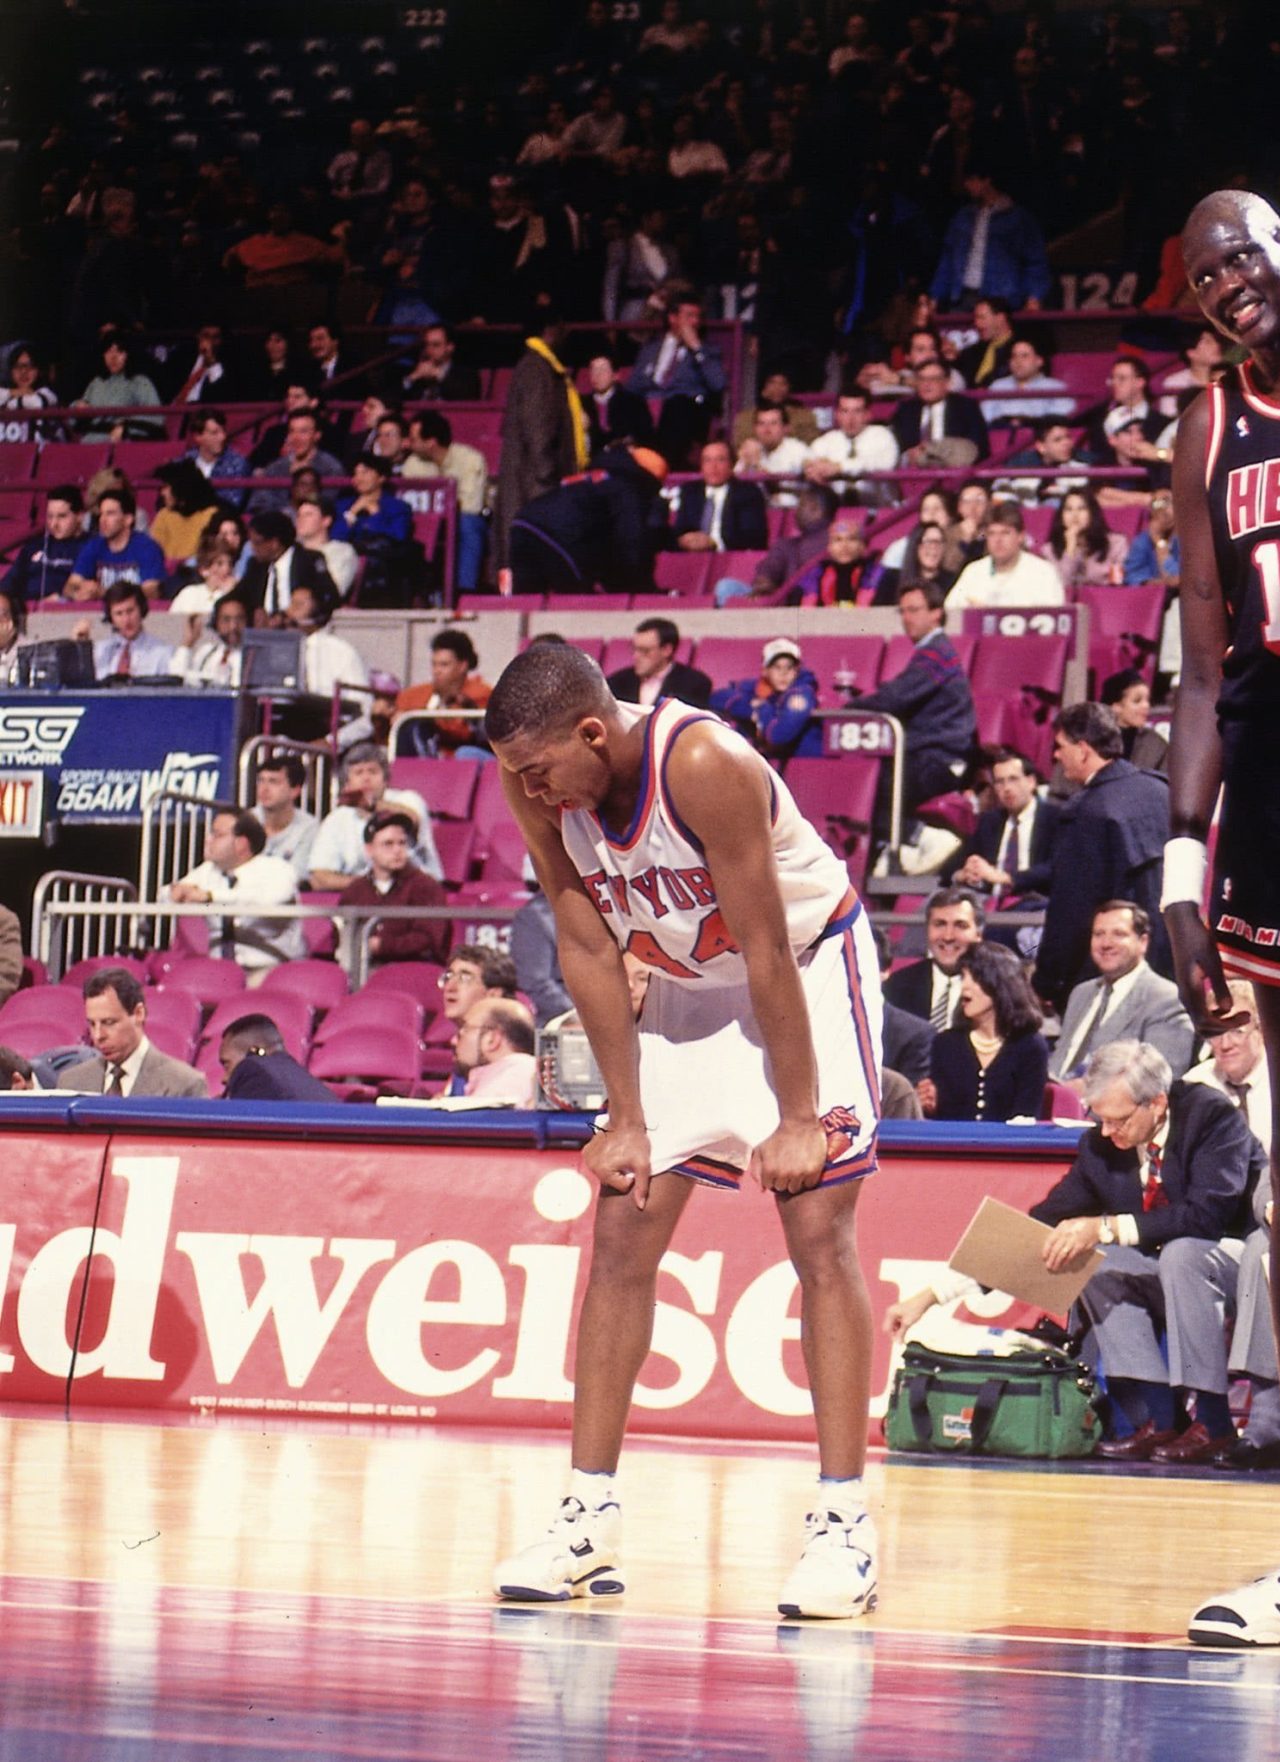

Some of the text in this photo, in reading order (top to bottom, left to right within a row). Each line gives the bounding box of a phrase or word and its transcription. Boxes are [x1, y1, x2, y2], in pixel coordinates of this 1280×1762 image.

[0, 706, 86, 751] SG
[841, 722, 881, 751] 83
[0, 780, 32, 826] XIT
[57, 781, 139, 812] 66AM
[629, 865, 717, 919] YOR
